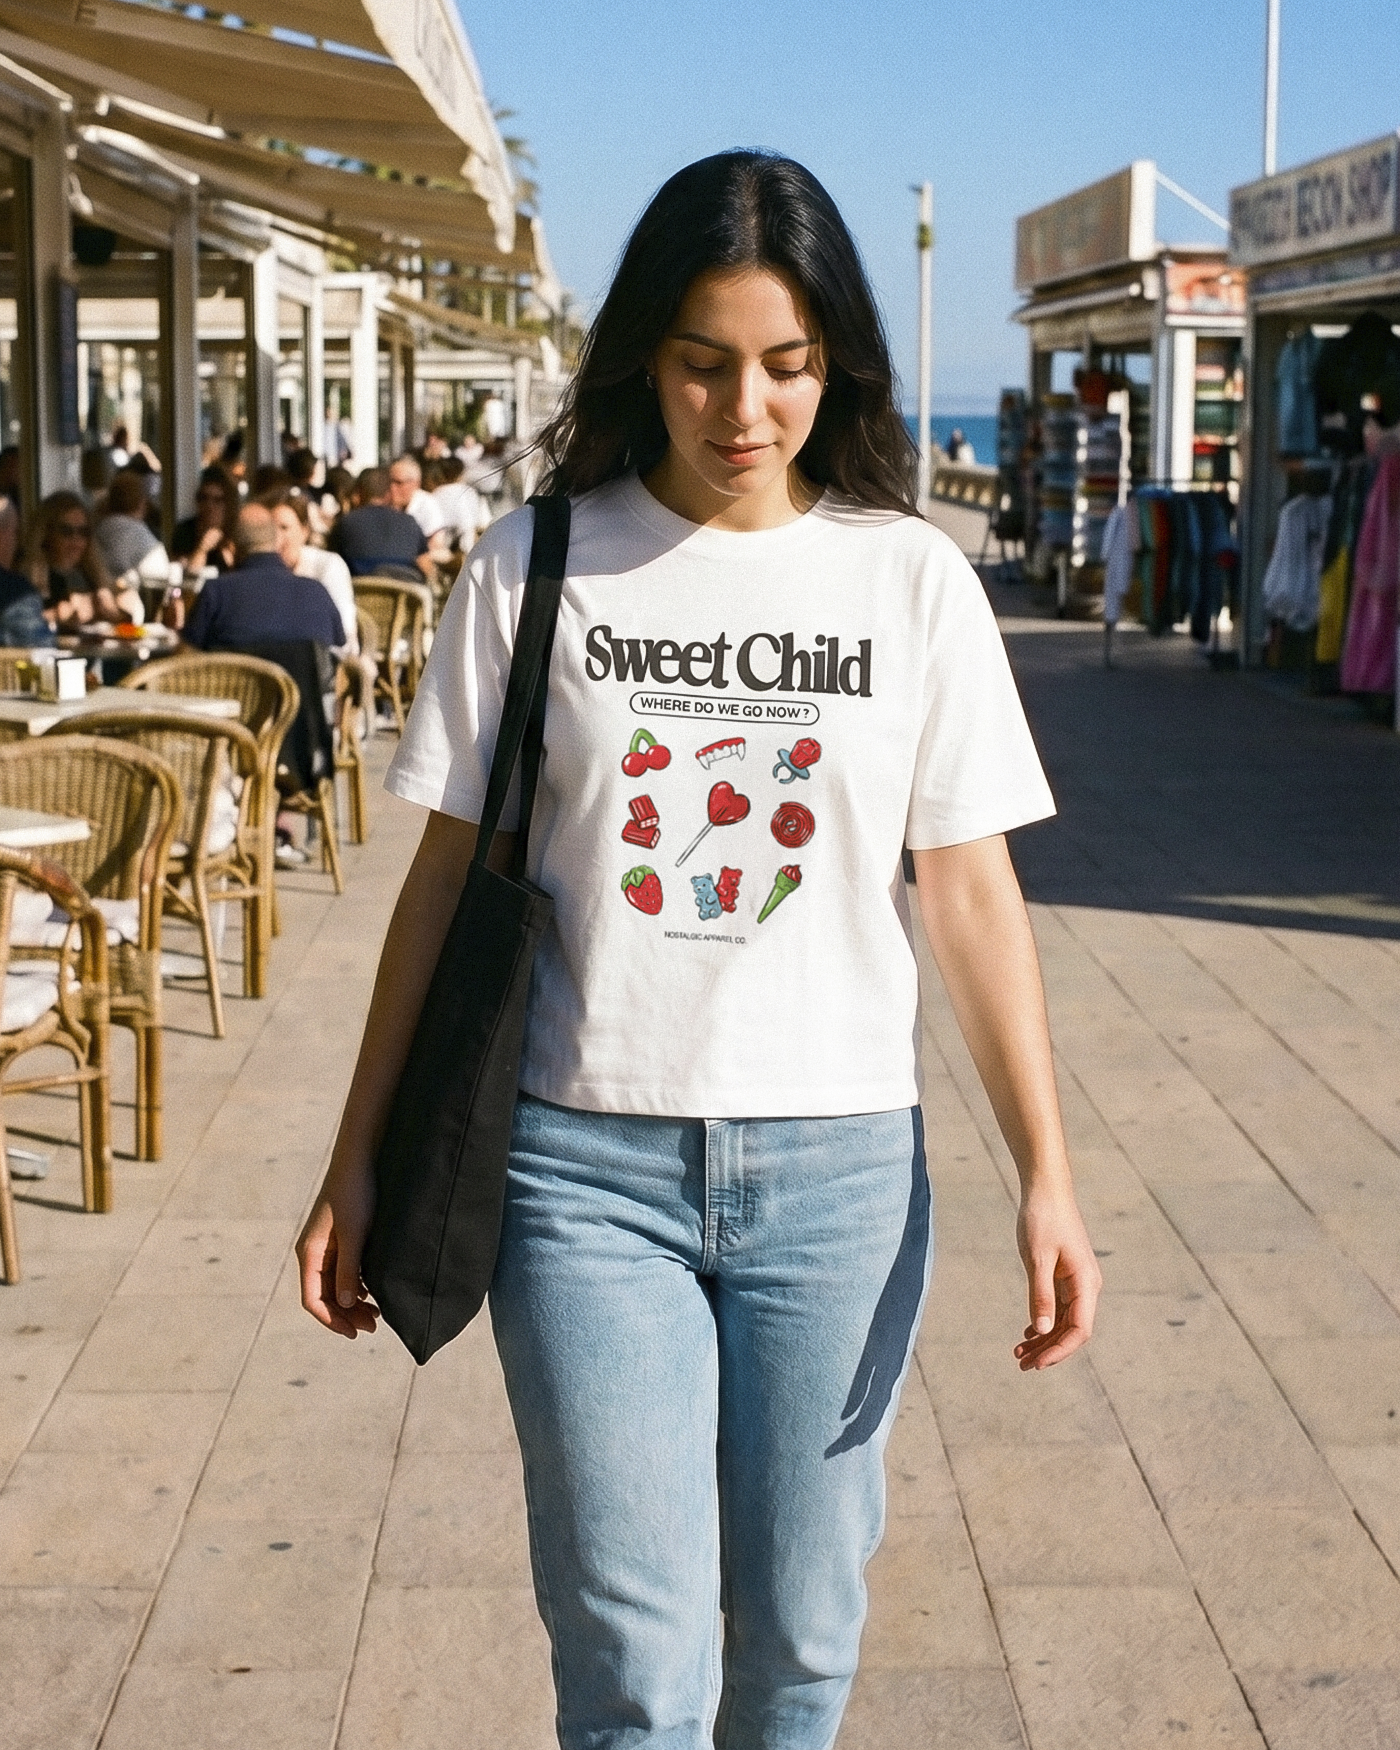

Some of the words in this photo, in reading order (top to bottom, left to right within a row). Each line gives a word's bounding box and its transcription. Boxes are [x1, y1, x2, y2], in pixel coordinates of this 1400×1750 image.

[585, 624, 732, 689] Sweet
[736, 632, 873, 697] Child
[640, 697, 691, 712] WHERE
[694, 702, 714, 714] DO
[718, 703, 739, 716] WE
[742, 705, 763, 717] GO
[766, 706, 801, 718] NOW
[664, 931, 702, 940] NOSTALGIC
[703, 934, 734, 943] APPAREL
